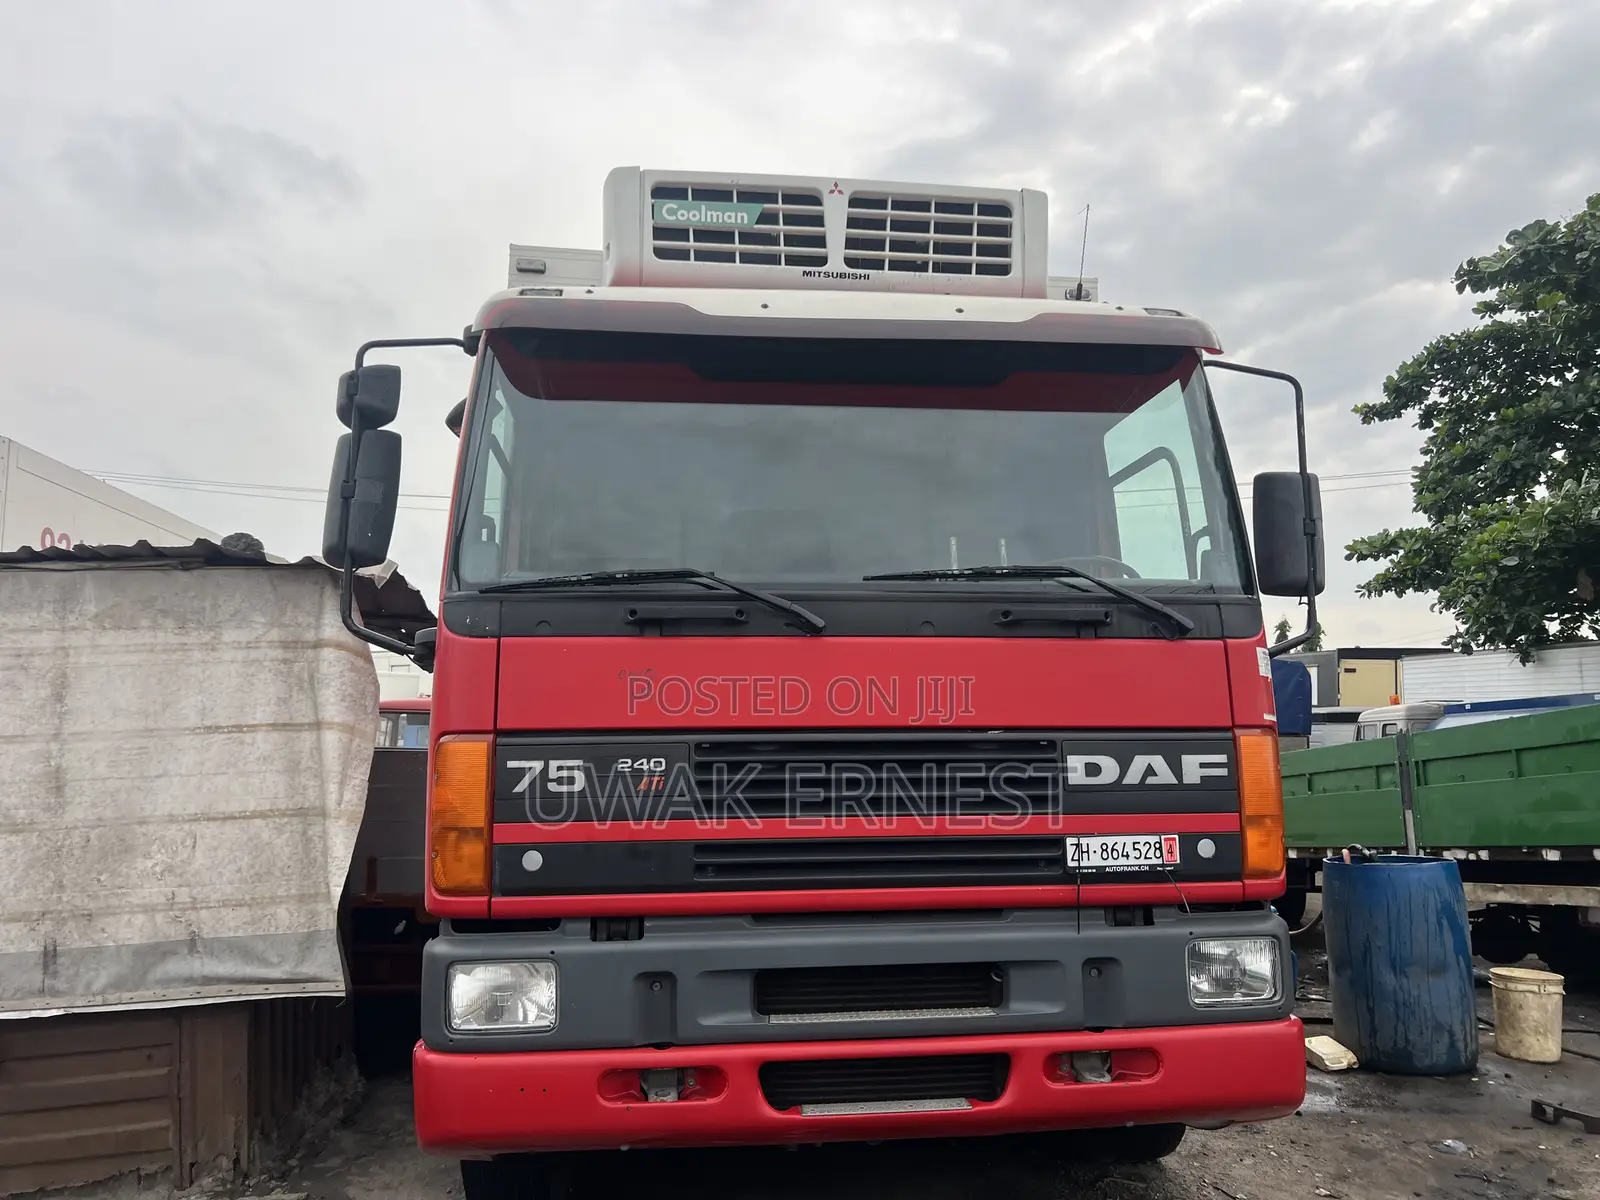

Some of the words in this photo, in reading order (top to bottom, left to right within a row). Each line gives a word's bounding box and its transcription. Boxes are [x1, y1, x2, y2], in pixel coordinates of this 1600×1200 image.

[661, 203, 748, 224] Coolman
[802, 270, 870, 281] MITSUBISHI
[616, 758, 666, 772] 240
[1066, 754, 1229, 785] DAF
[506, 760, 585, 793] 75
[1105, 865, 1149, 873] AUTOFRANK.CH
